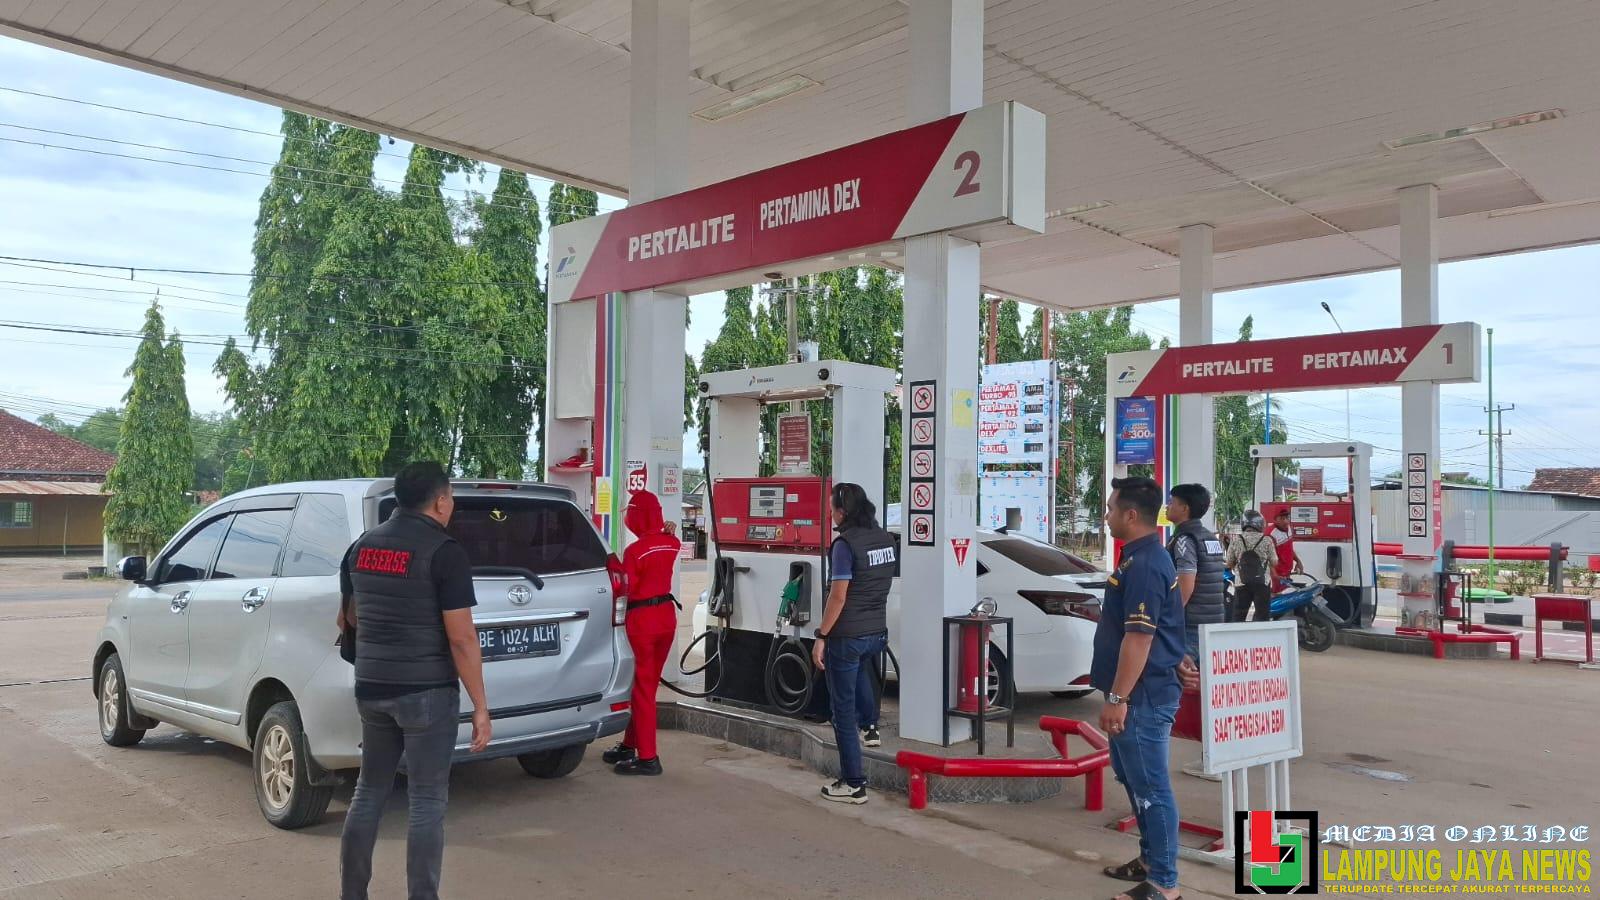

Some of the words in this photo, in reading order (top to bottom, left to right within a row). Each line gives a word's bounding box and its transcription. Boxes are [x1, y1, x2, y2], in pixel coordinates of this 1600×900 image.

[953, 150, 981, 198] 2
[628, 213, 735, 262] PERTALITE
[760, 187, 830, 231] PERTAMINA
[833, 178, 862, 213] DEX
[1182, 357, 1274, 378] PERTALITE
[1302, 346, 1407, 371] PERTAMAX
[1441, 343, 1454, 365] 1
[479, 631, 495, 648] BE
[500, 628, 529, 645] 1024
[533, 625, 555, 642] ALH
[1212, 650, 1249, 675] DILARANG
[1250, 646, 1282, 672] MEROKOK
[1215, 716, 1233, 743] SAAT
[1235, 711, 1270, 739] PENGISIAN
[1272, 709, 1285, 734] BBM
